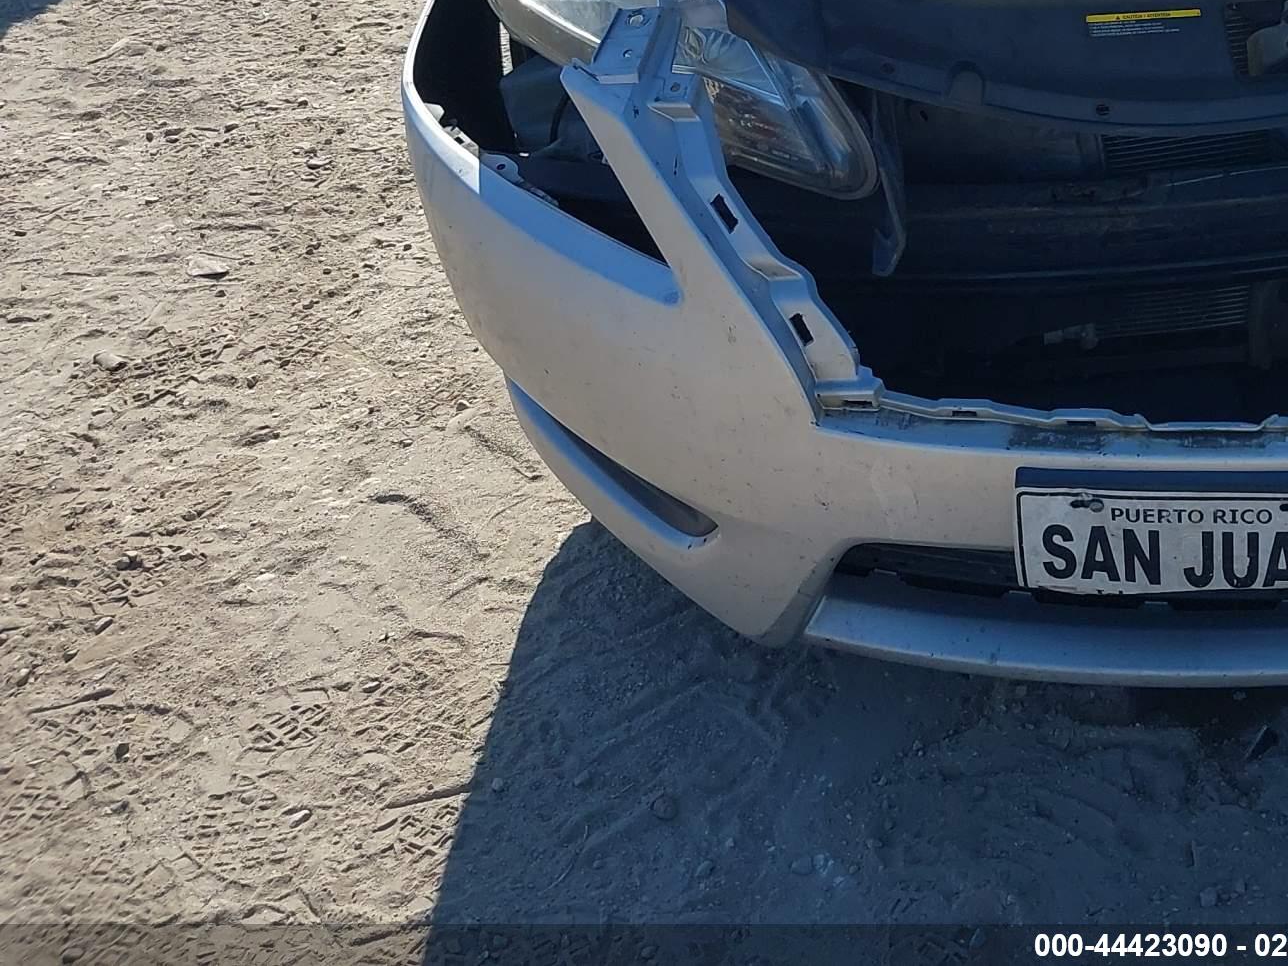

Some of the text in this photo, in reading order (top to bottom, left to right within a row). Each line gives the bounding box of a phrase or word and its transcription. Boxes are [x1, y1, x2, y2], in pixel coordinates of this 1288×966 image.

[1110, 507, 1273, 525] PUERTO RICO
[1042, 524, 1161, 586] SAN
